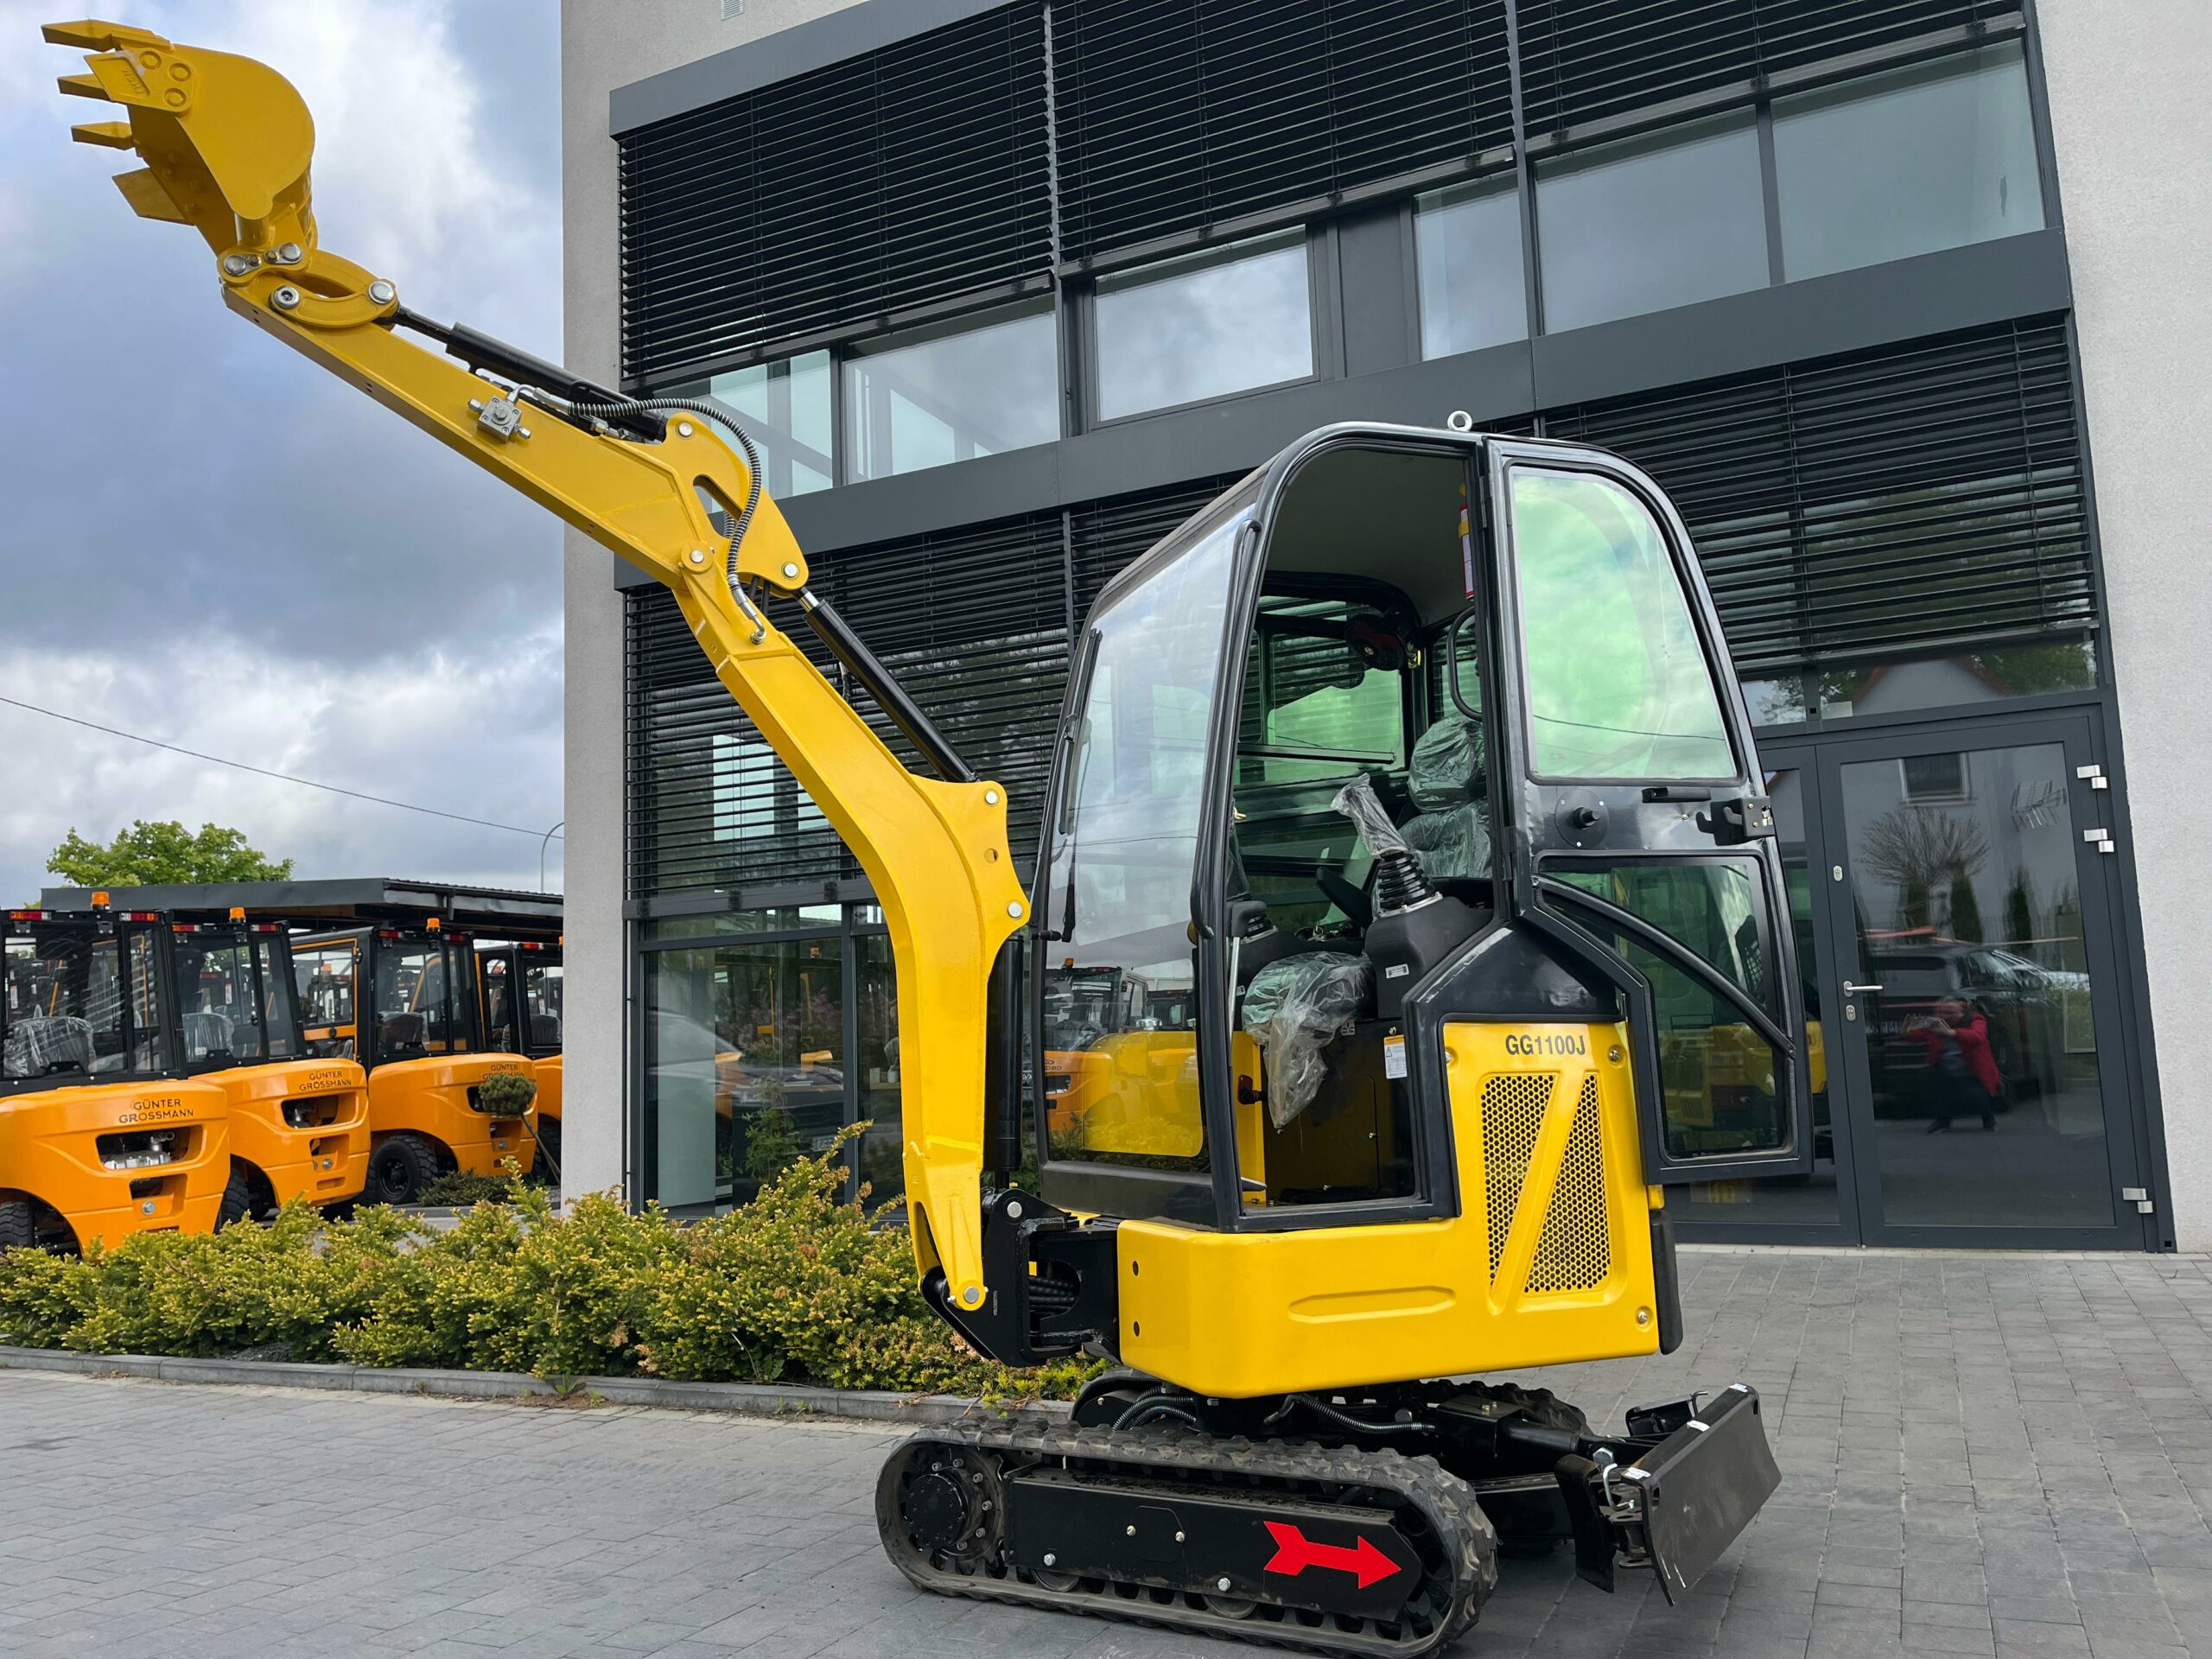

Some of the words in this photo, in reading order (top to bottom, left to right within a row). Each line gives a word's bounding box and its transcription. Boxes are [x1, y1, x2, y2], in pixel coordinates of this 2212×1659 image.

[1505, 1034, 1586, 1056] GG1100J
[308, 1071, 343, 1081] GÜNTER
[299, 1078, 352, 1091] GROSSMANN
[133, 1098, 181, 1110] GÜNTER
[118, 1109, 194, 1123] GROSSMANN
